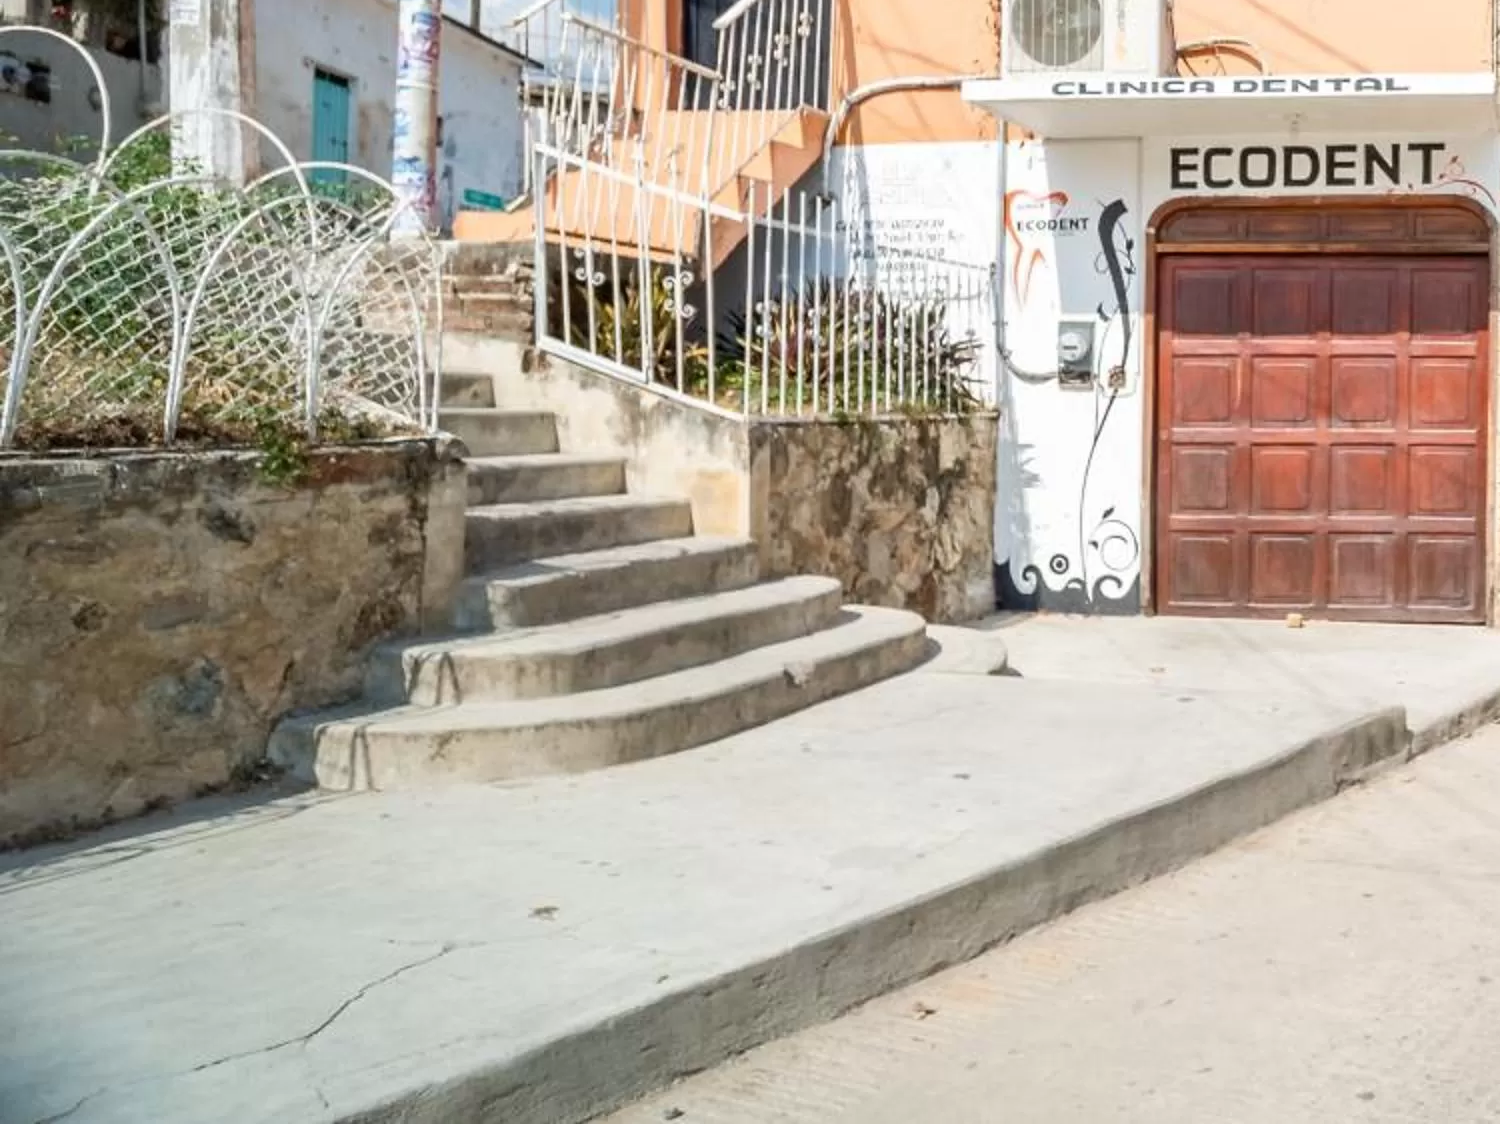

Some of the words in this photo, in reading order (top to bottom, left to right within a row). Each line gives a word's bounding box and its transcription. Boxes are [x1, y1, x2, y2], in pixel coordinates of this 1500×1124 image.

[1051, 80, 1215, 96] CLINICA
[1232, 77, 1410, 94] DENTAL
[1170, 143, 1446, 189] ECODENT
[1016, 217, 1089, 232] ECODENT
